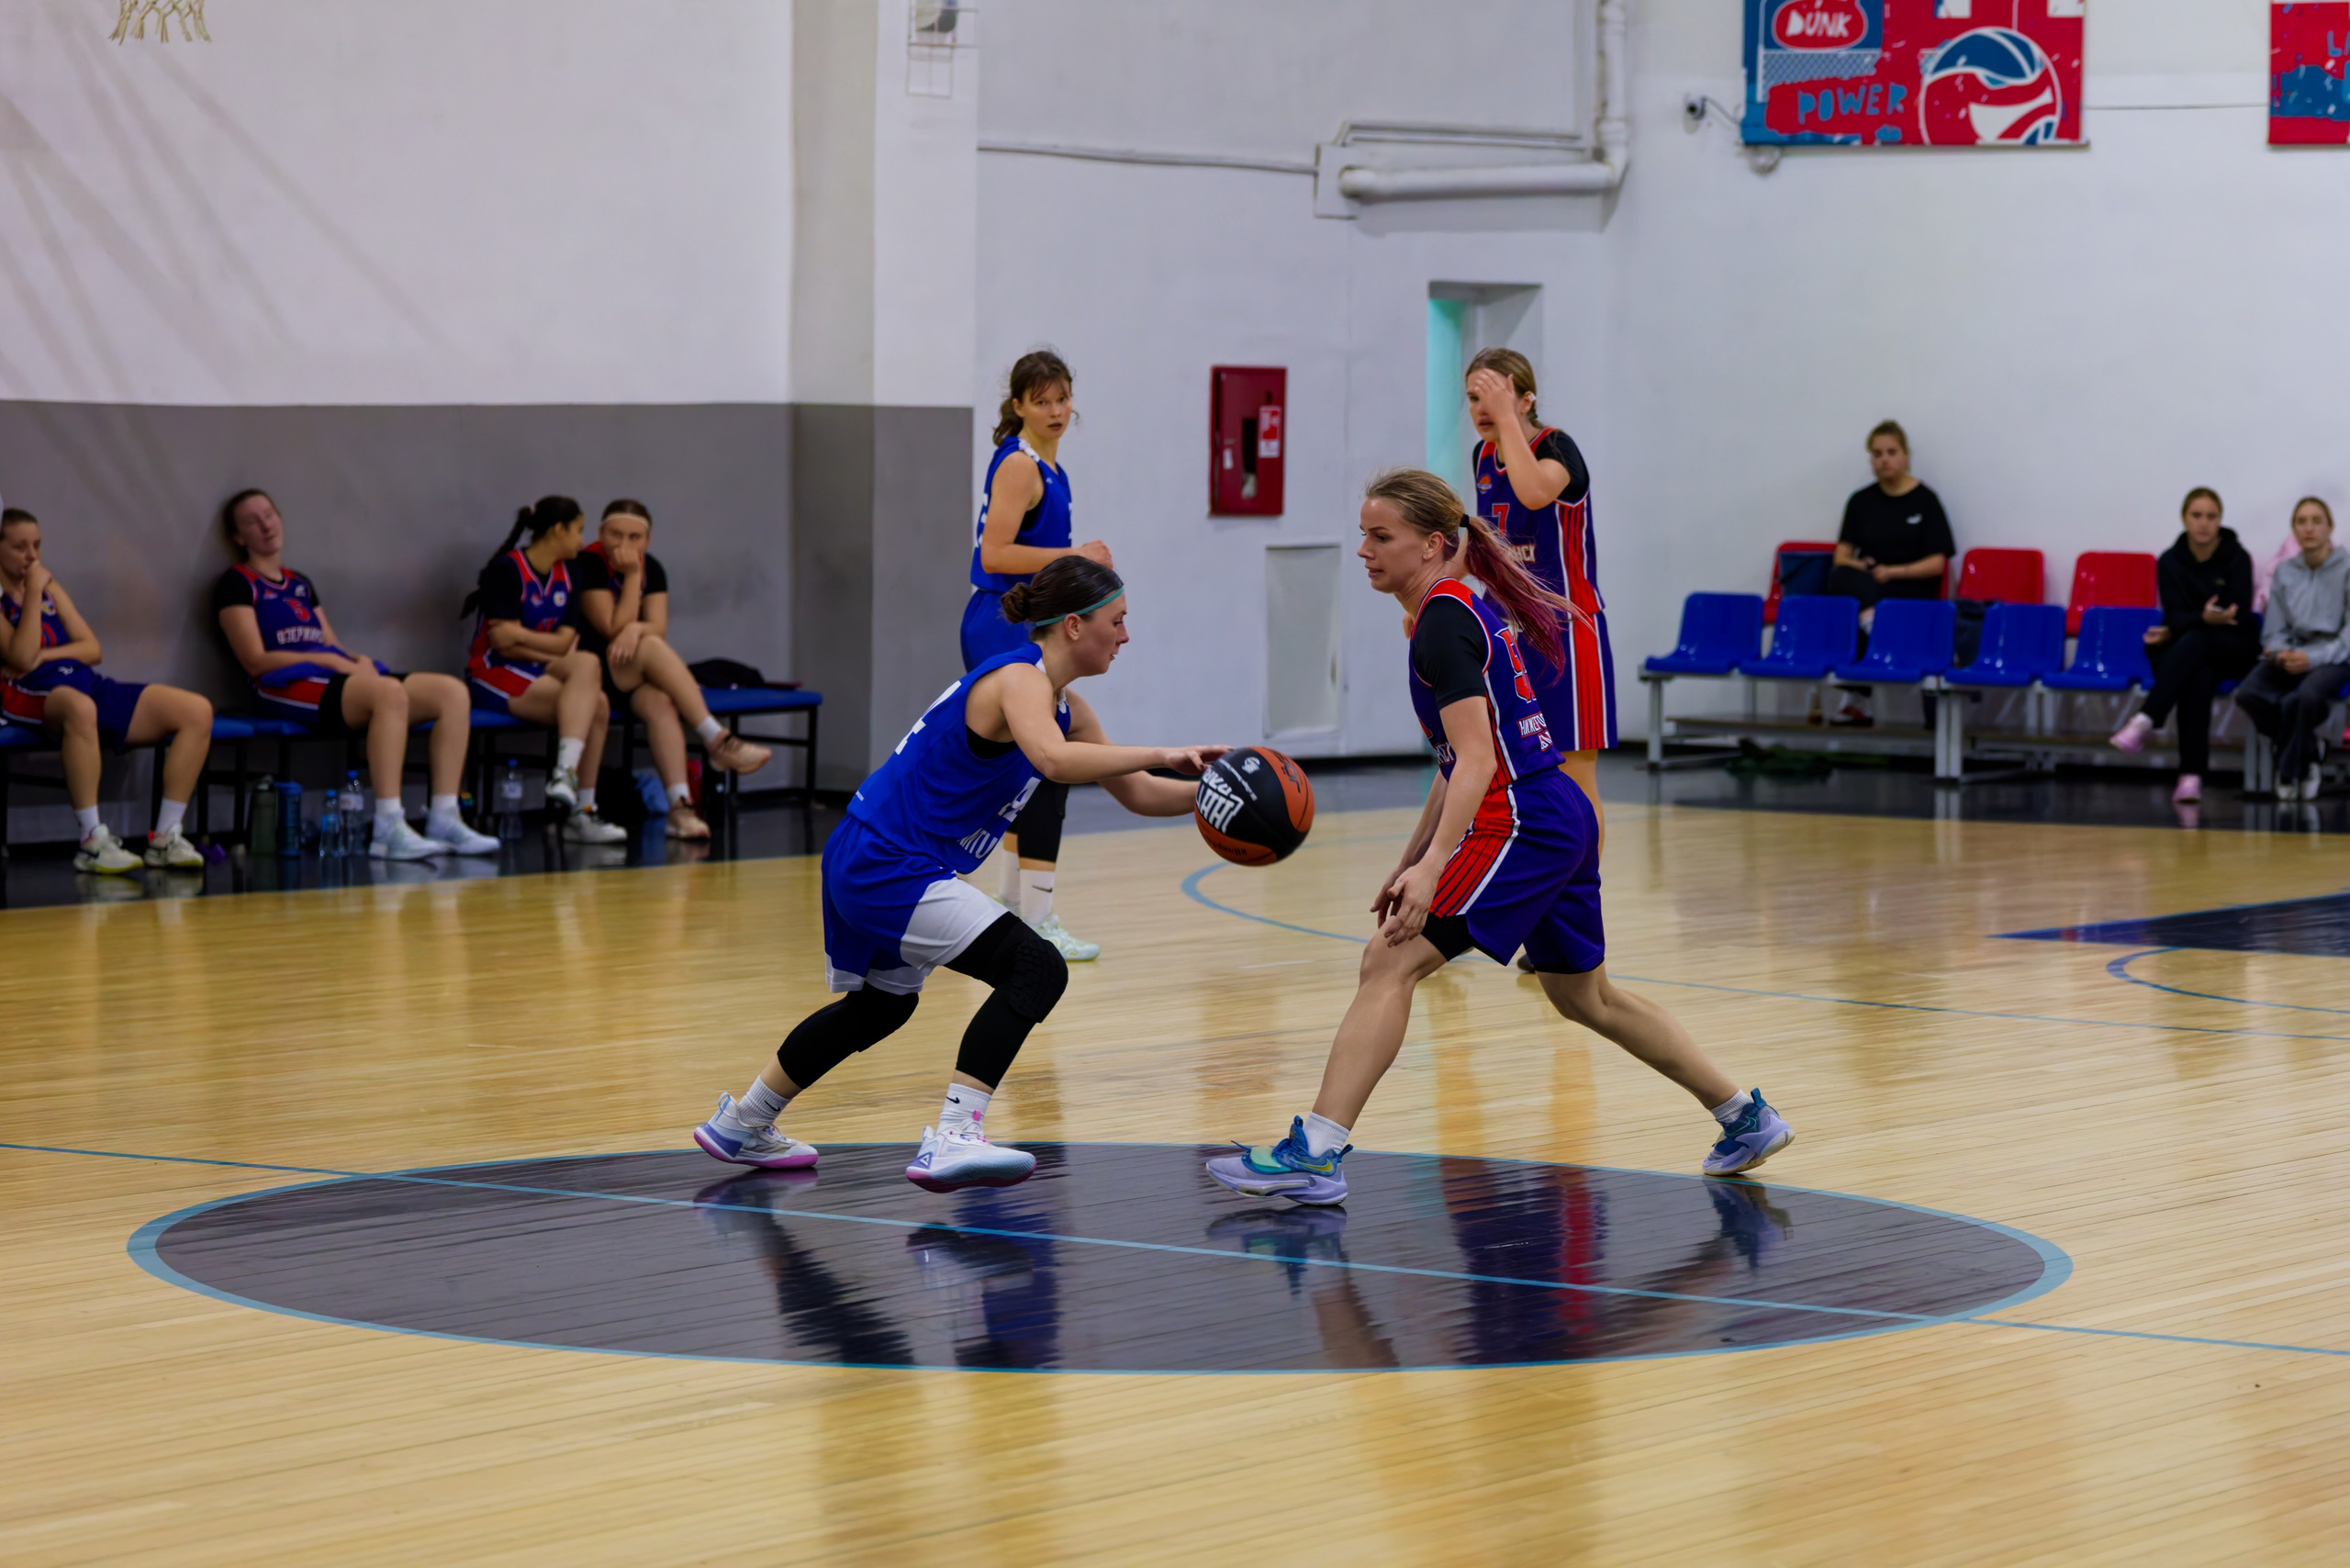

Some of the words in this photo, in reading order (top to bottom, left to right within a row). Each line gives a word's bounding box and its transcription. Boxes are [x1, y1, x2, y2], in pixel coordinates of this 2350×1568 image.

[1785, 9, 1852, 38] DUNK
[1797, 81, 1908, 125] POWER
[1492, 503, 1510, 538] 7
